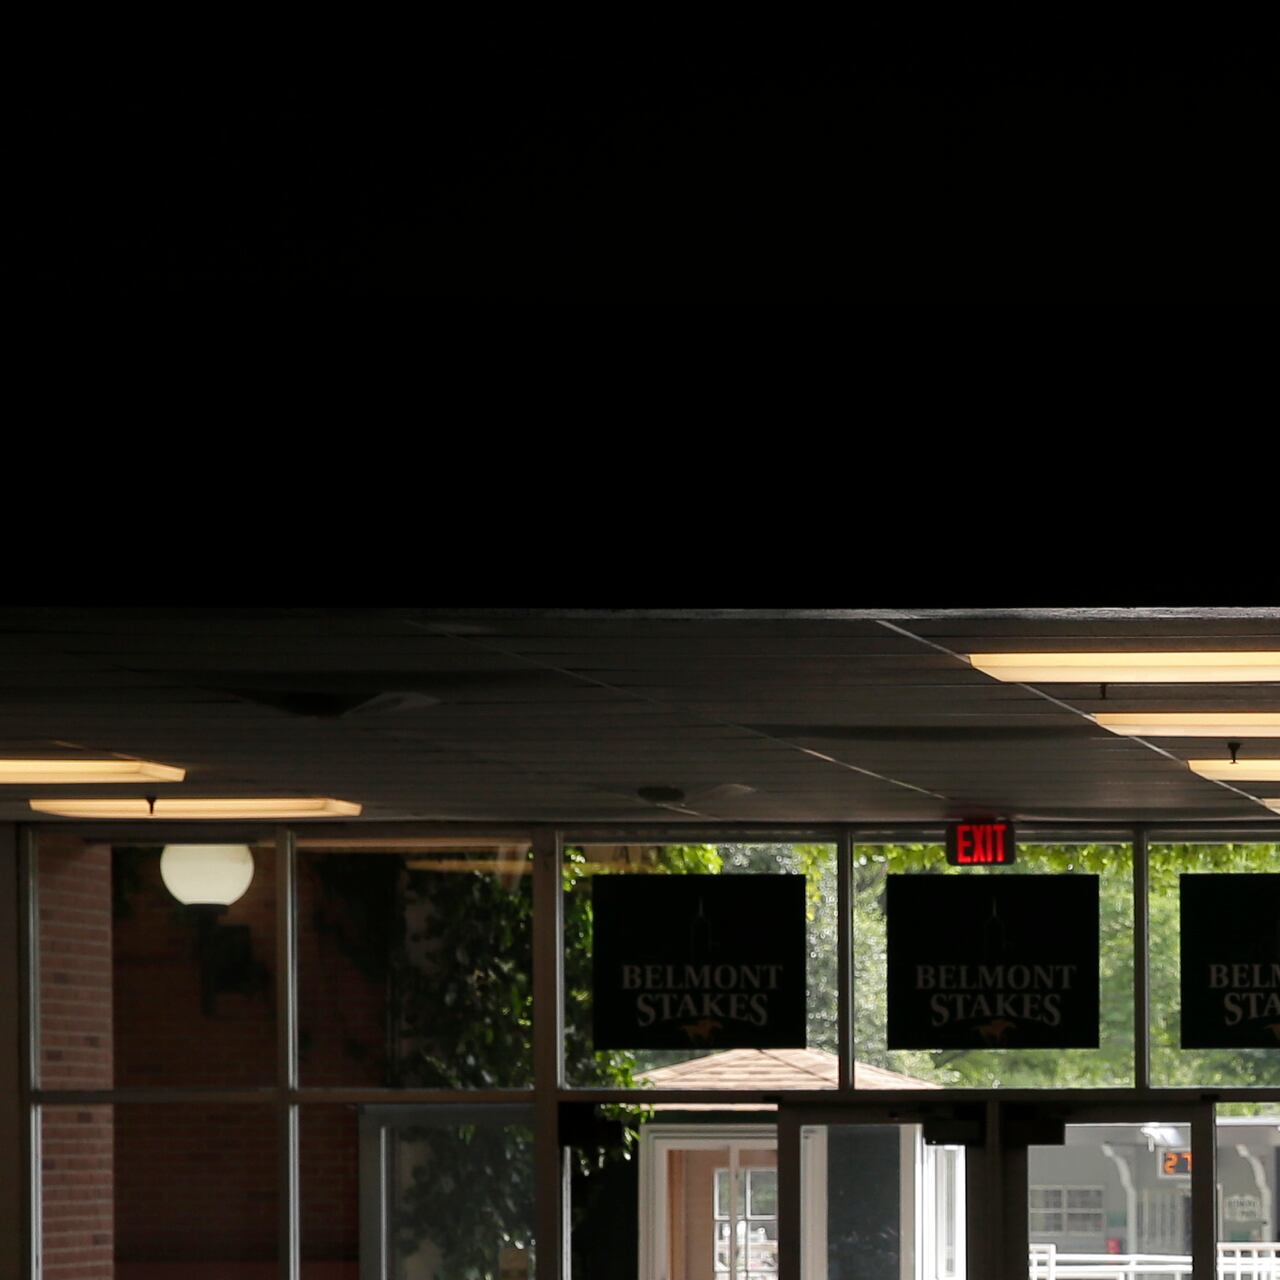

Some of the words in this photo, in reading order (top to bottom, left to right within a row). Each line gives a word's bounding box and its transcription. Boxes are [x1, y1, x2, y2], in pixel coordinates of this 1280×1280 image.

[957, 824, 1007, 863] EXIT
[620, 963, 784, 991] BELMONT
[914, 963, 1078, 991] BELMONT
[635, 992, 769, 1028] STAKES
[930, 992, 1063, 1028] STAKES
